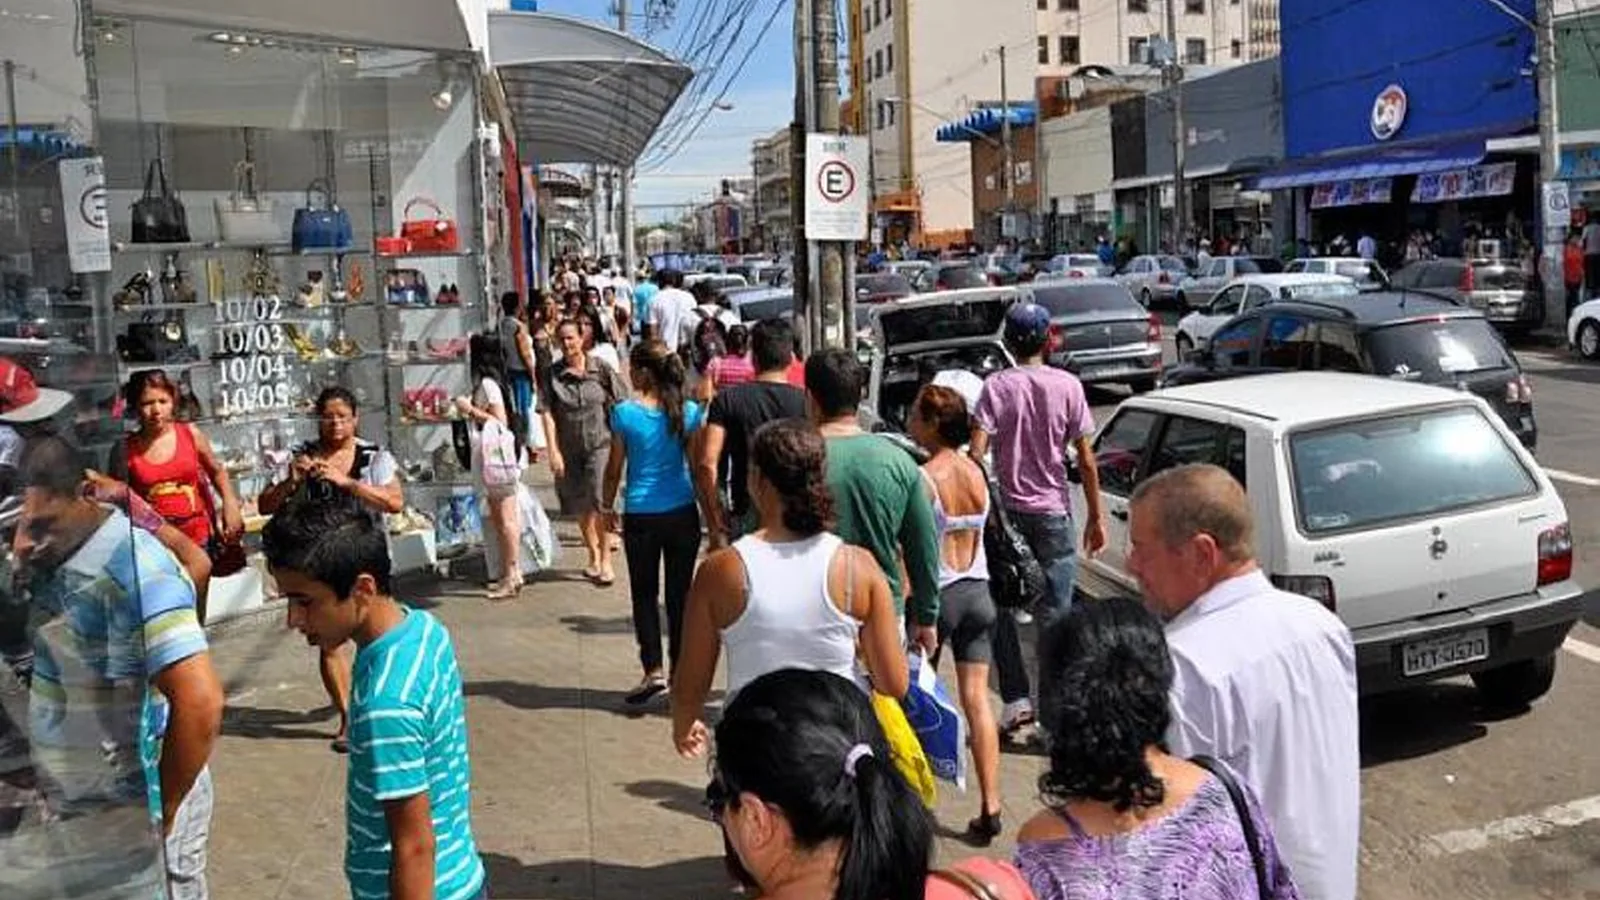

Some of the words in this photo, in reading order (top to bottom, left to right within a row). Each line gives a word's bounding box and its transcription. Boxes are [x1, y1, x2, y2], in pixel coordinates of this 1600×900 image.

[827, 170, 843, 194] E
[215, 294, 282, 321] 10/02
[217, 323, 284, 353] 10/03
[220, 354, 288, 384] 10/04
